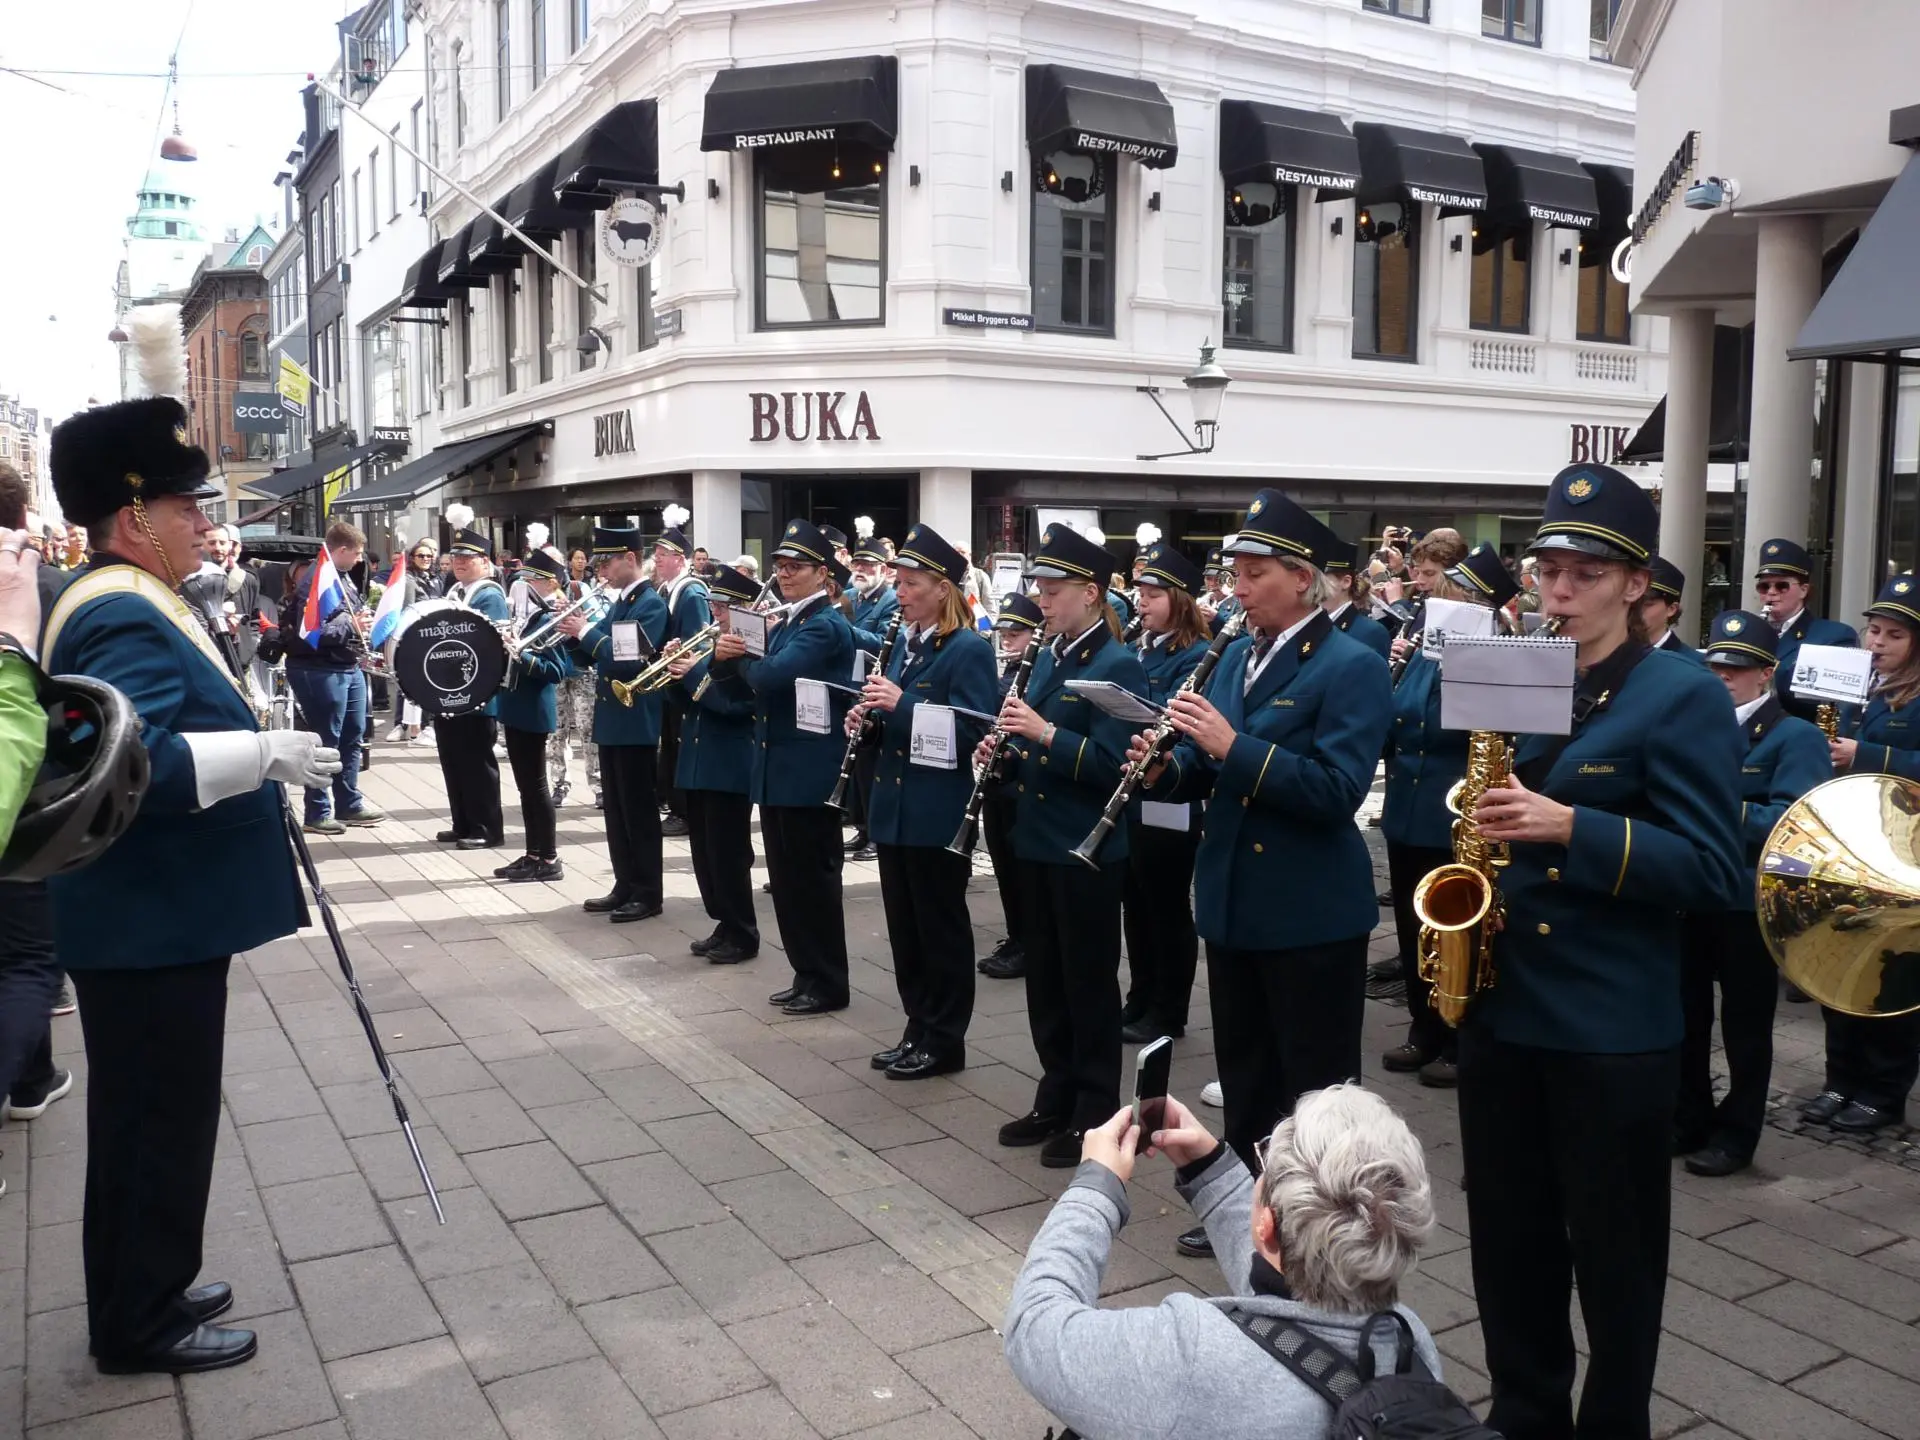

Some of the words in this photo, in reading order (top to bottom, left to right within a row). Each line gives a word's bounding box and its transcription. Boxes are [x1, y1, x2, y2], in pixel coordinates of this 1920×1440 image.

[735, 129, 836, 148] RESTAURANT
[1077, 133, 1167, 159] RESTAURANT
[1275, 167, 1356, 189] RESTAURANT
[1411, 187, 1482, 208] RESTAURANT
[1530, 206, 1593, 227] RESTAURANT
[952, 311, 976, 323] Mikkel
[977, 314, 1009, 326] Bryggers
[1010, 316, 1029, 327] Gade
[749, 390, 882, 442] BUKA
[374, 430, 409, 441] NEYE
[594, 408, 636, 457] BUKA
[1569, 423, 1649, 466] BUK
[419, 621, 477, 640] majestic
[429, 650, 469, 660] AMICITIA
